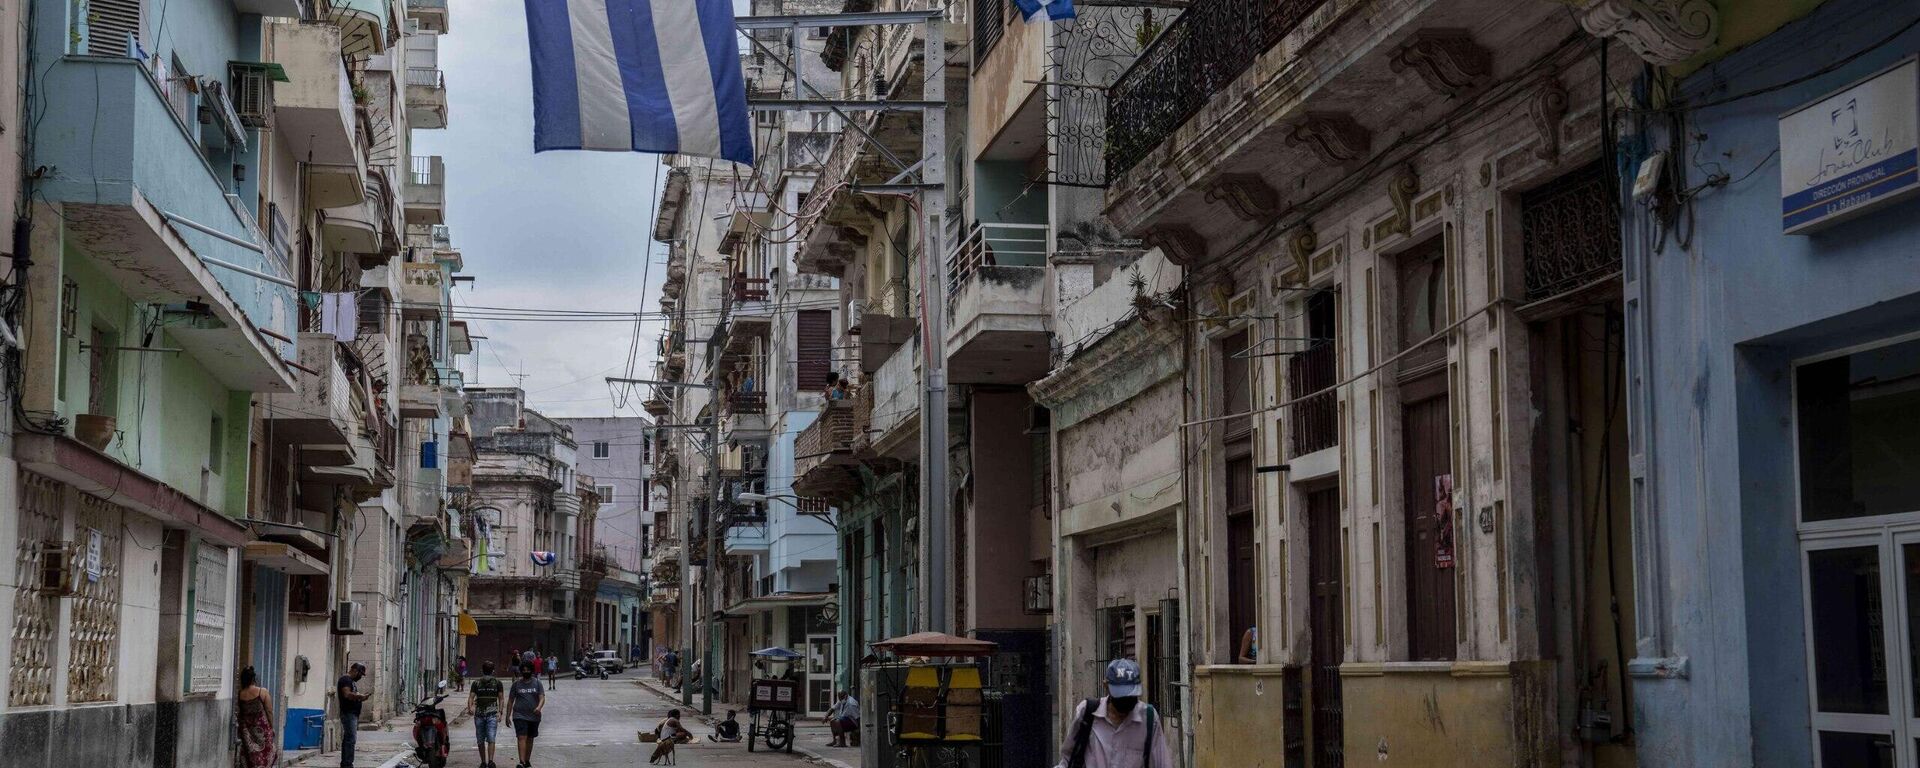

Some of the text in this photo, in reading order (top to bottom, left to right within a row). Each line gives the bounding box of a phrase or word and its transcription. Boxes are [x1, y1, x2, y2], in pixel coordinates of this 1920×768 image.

[1847, 166, 1886, 189] PROVINCIAL
[1827, 191, 1872, 215] La Habana
